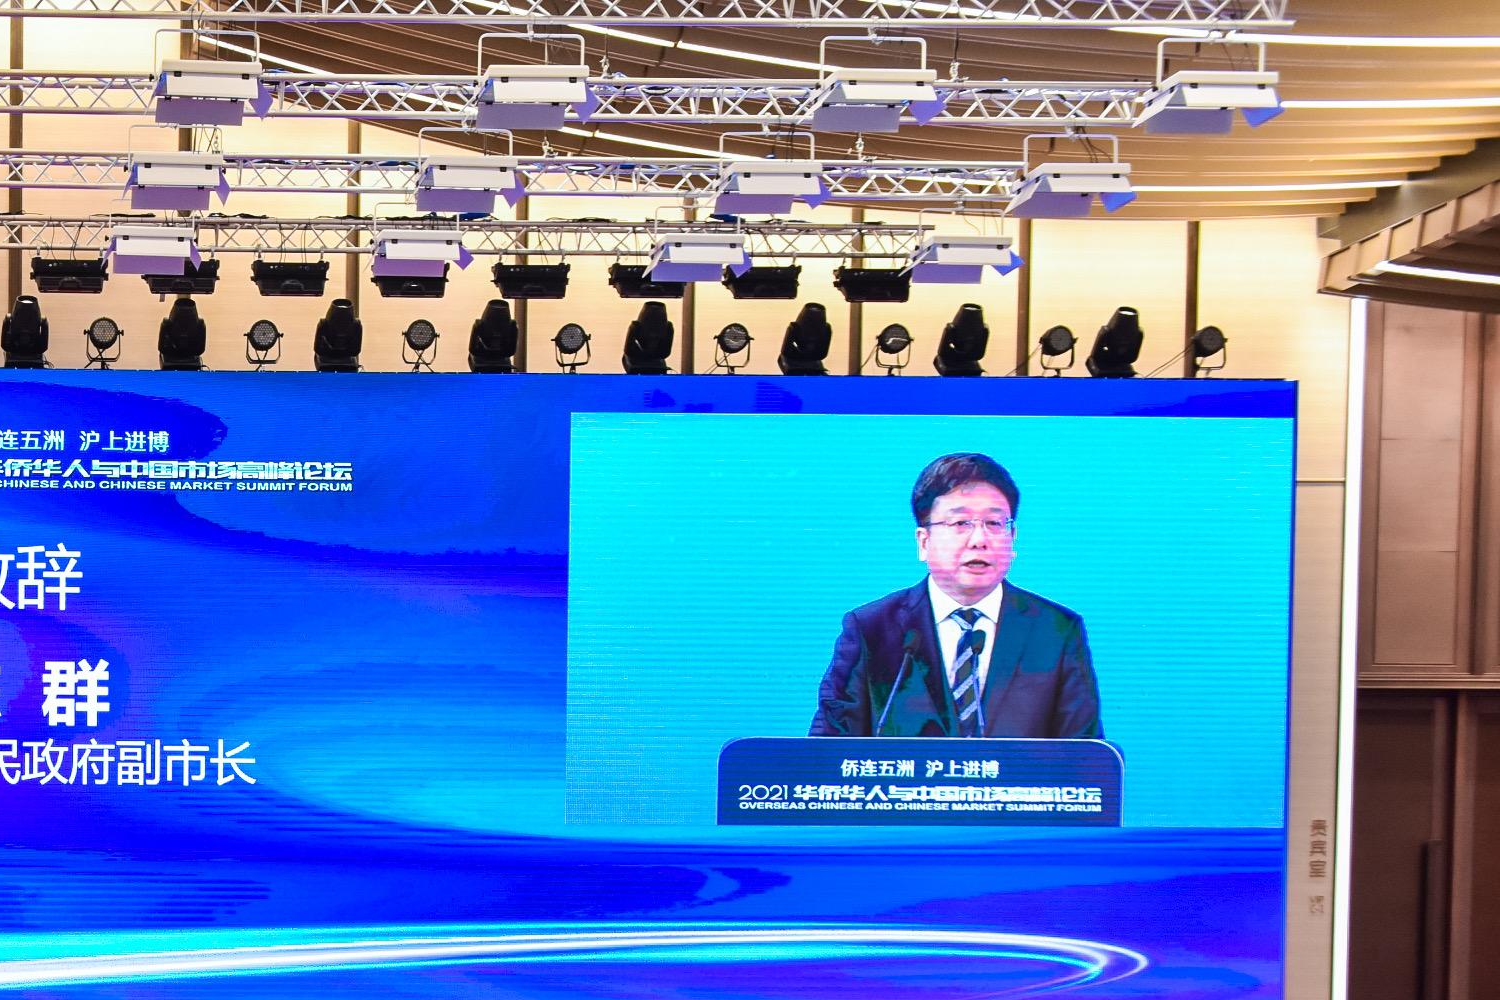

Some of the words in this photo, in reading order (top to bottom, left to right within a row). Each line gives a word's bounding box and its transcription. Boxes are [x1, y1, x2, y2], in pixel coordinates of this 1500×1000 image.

[79, 430, 169, 452] 沪上进博
[63, 480, 96, 489] AND
[98, 480, 166, 490] CHINESE
[170, 481, 233, 490] MARKET
[236, 482, 296, 491] SUMMIT
[299, 482, 353, 491] FORUM
[41, 658, 111, 727] 群
[840, 759, 915, 777] 侨连五洲
[925, 759, 999, 778] 沪上进博
[738, 784, 788, 800] 2021
[739, 801, 806, 810] OVERSEAS
[808, 802, 863, 810] CHINESE
[865, 802, 892, 810] AND
[894, 803, 950, 811] CHINESE
[951, 803, 1005, 811] MARKET
[1006, 803, 1055, 812] SUMMIT
[1056, 803, 1102, 812] FORUM
